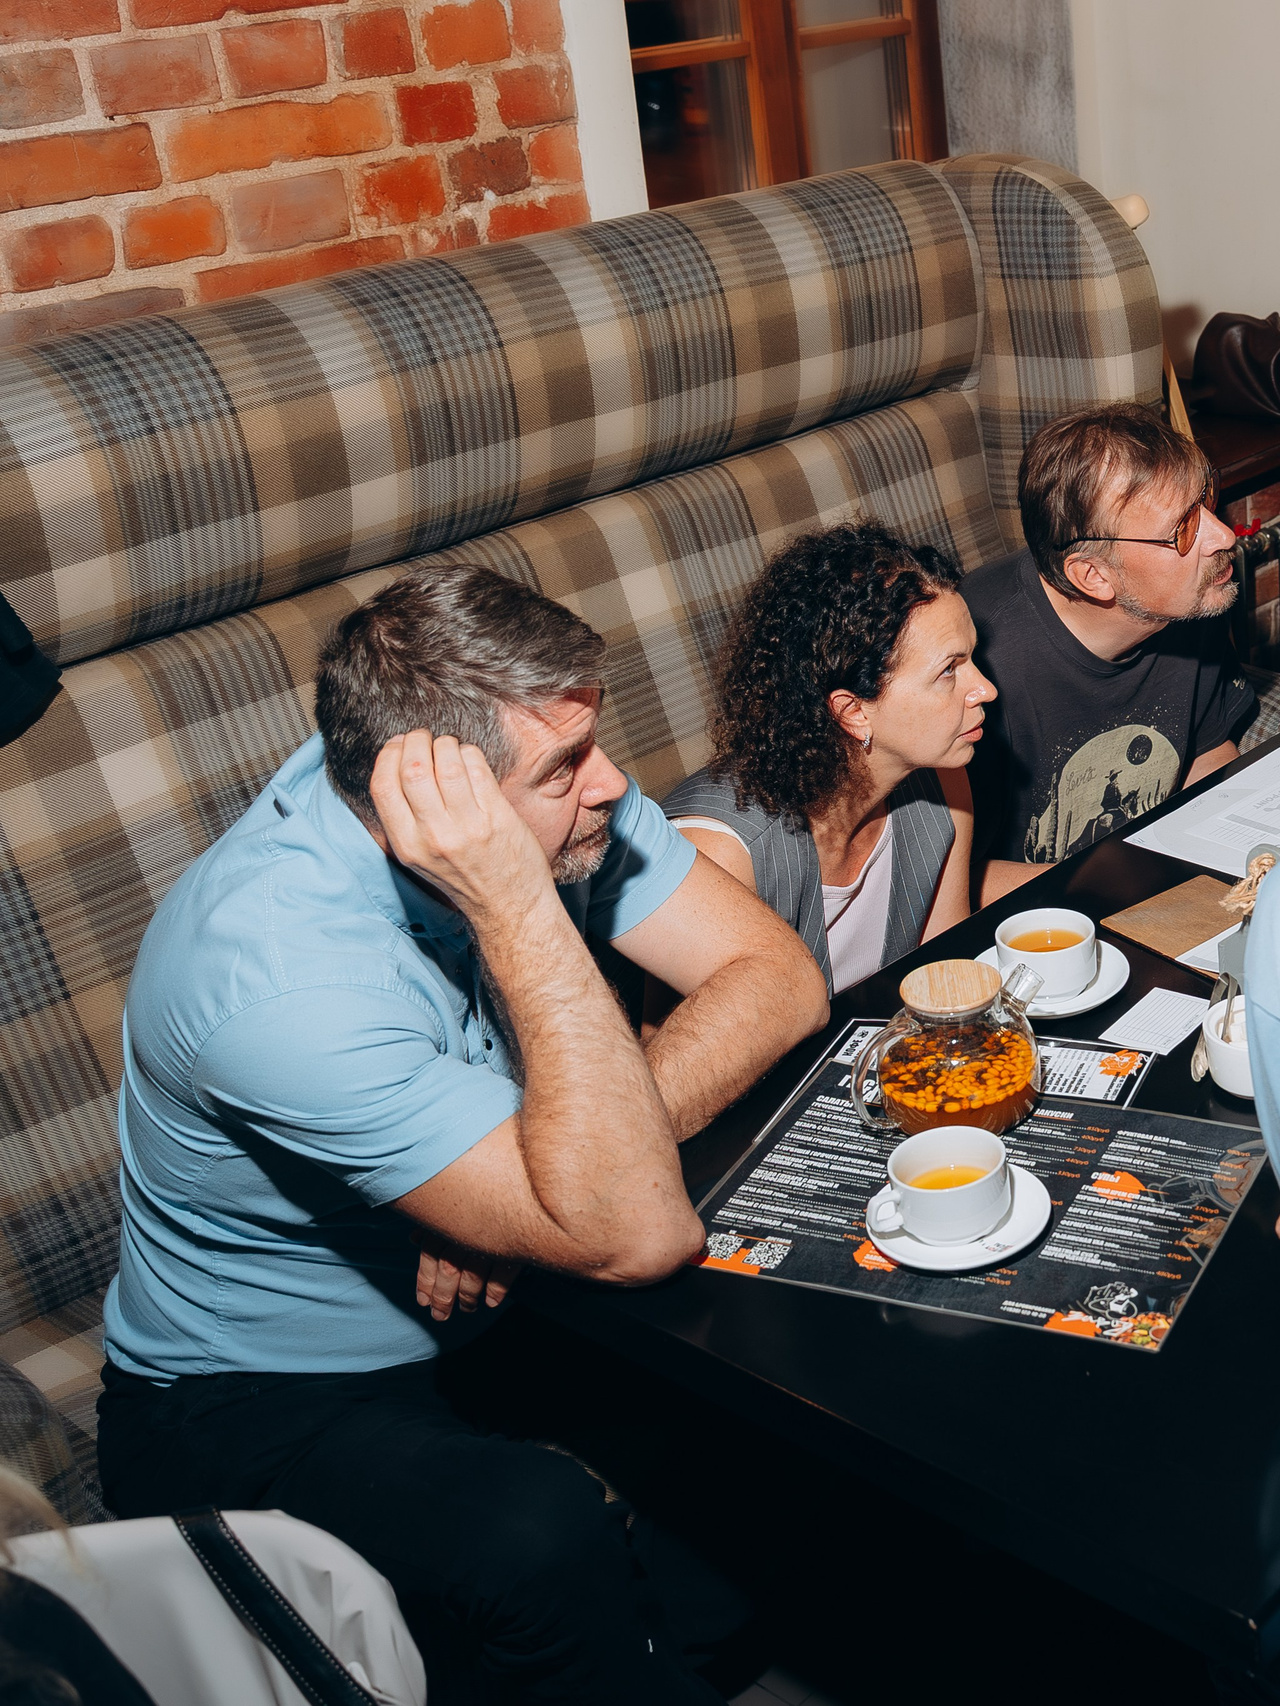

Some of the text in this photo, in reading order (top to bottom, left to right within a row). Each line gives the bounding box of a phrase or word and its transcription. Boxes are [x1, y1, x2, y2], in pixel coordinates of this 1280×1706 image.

[842, 1039, 863, 1056] КОФЕ
[814, 1094, 856, 1107] САЛАТЫ
[803, 1109, 828, 1118] ЦЕЗАРЬ
[793, 1120, 818, 1129] ЦЕЗАРЬ
[1089, 1171, 1121, 1183] СУПЫ
